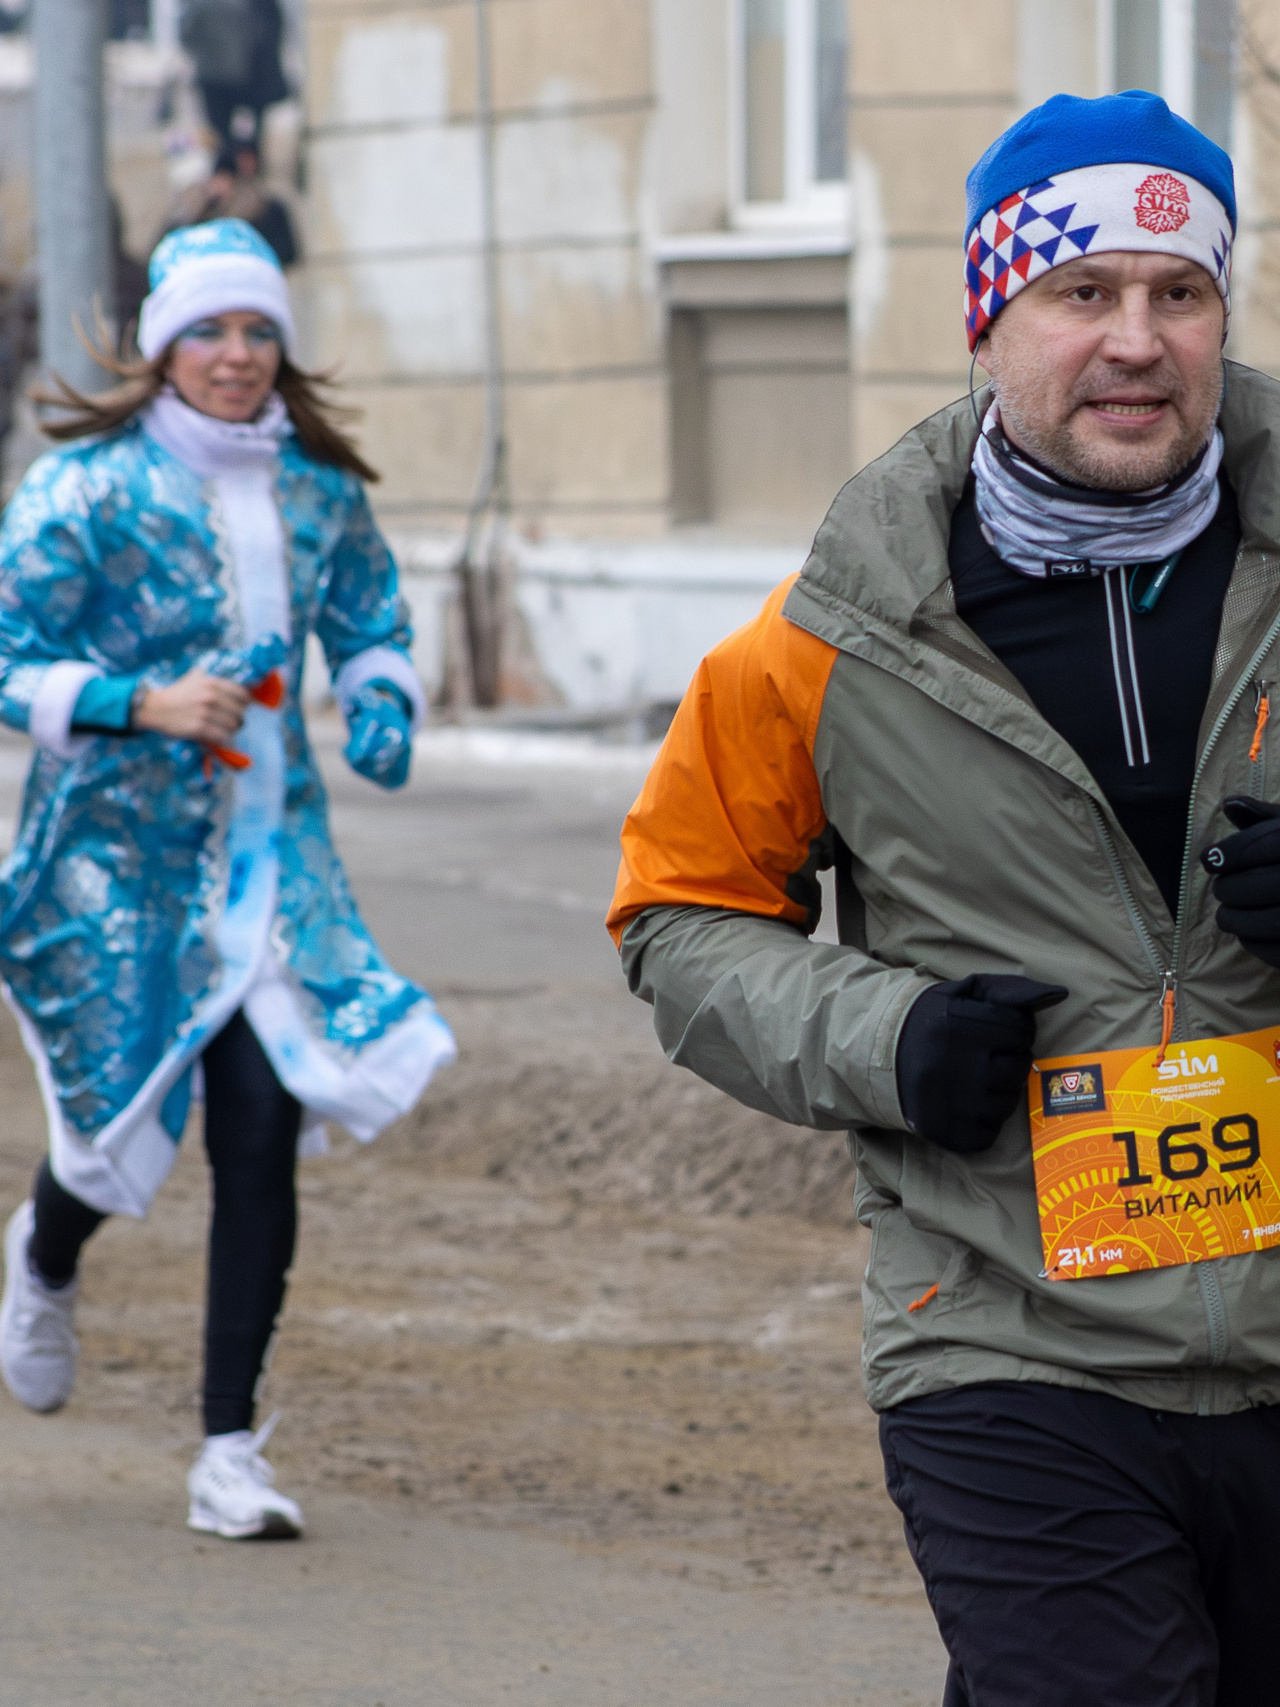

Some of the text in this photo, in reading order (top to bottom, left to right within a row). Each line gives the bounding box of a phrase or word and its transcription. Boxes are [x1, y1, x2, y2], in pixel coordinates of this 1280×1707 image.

[1112, 1113, 1261, 1188] 169
[1125, 1174, 1262, 1219] ВИТАЛИЙ
[1242, 1229, 1250, 1240] 7
[1057, 1245, 1095, 1267] 21,1
